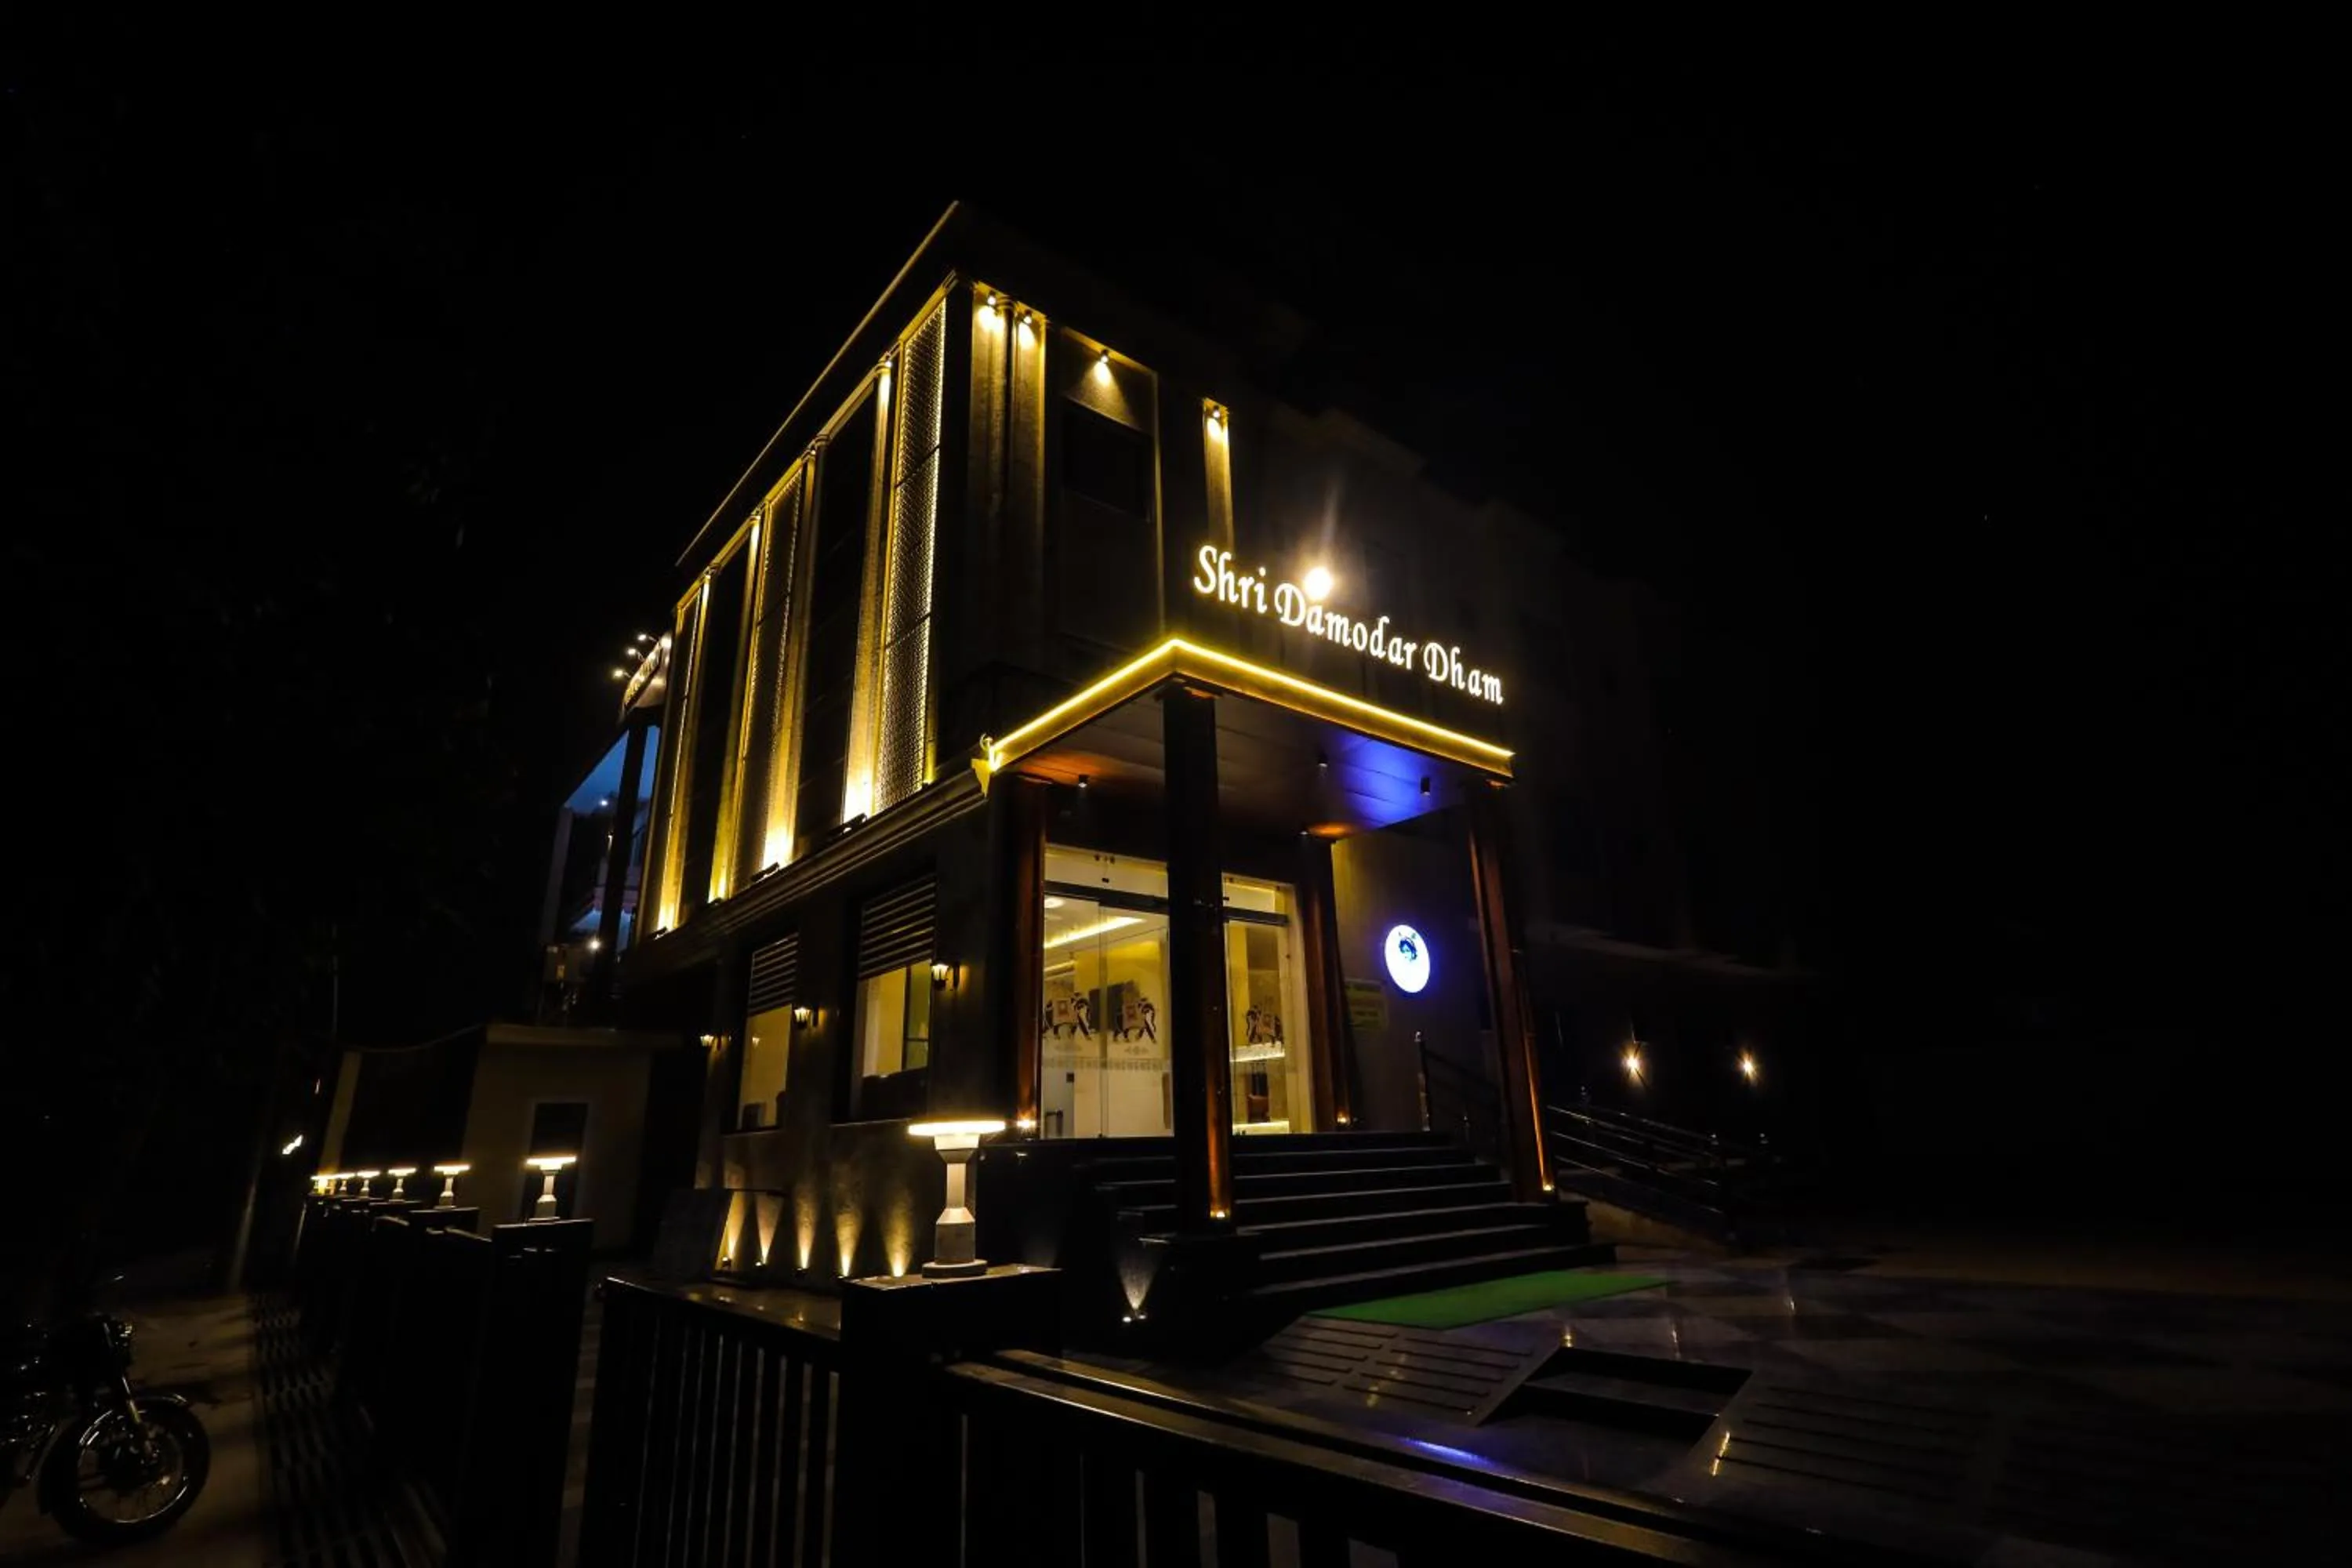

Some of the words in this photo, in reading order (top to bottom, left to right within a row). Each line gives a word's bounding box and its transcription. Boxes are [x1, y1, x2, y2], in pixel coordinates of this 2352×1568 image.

[1193, 545, 1268, 615] Shri
[1273, 582, 1417, 670] Damodar
[1423, 641, 1504, 706] Dham
